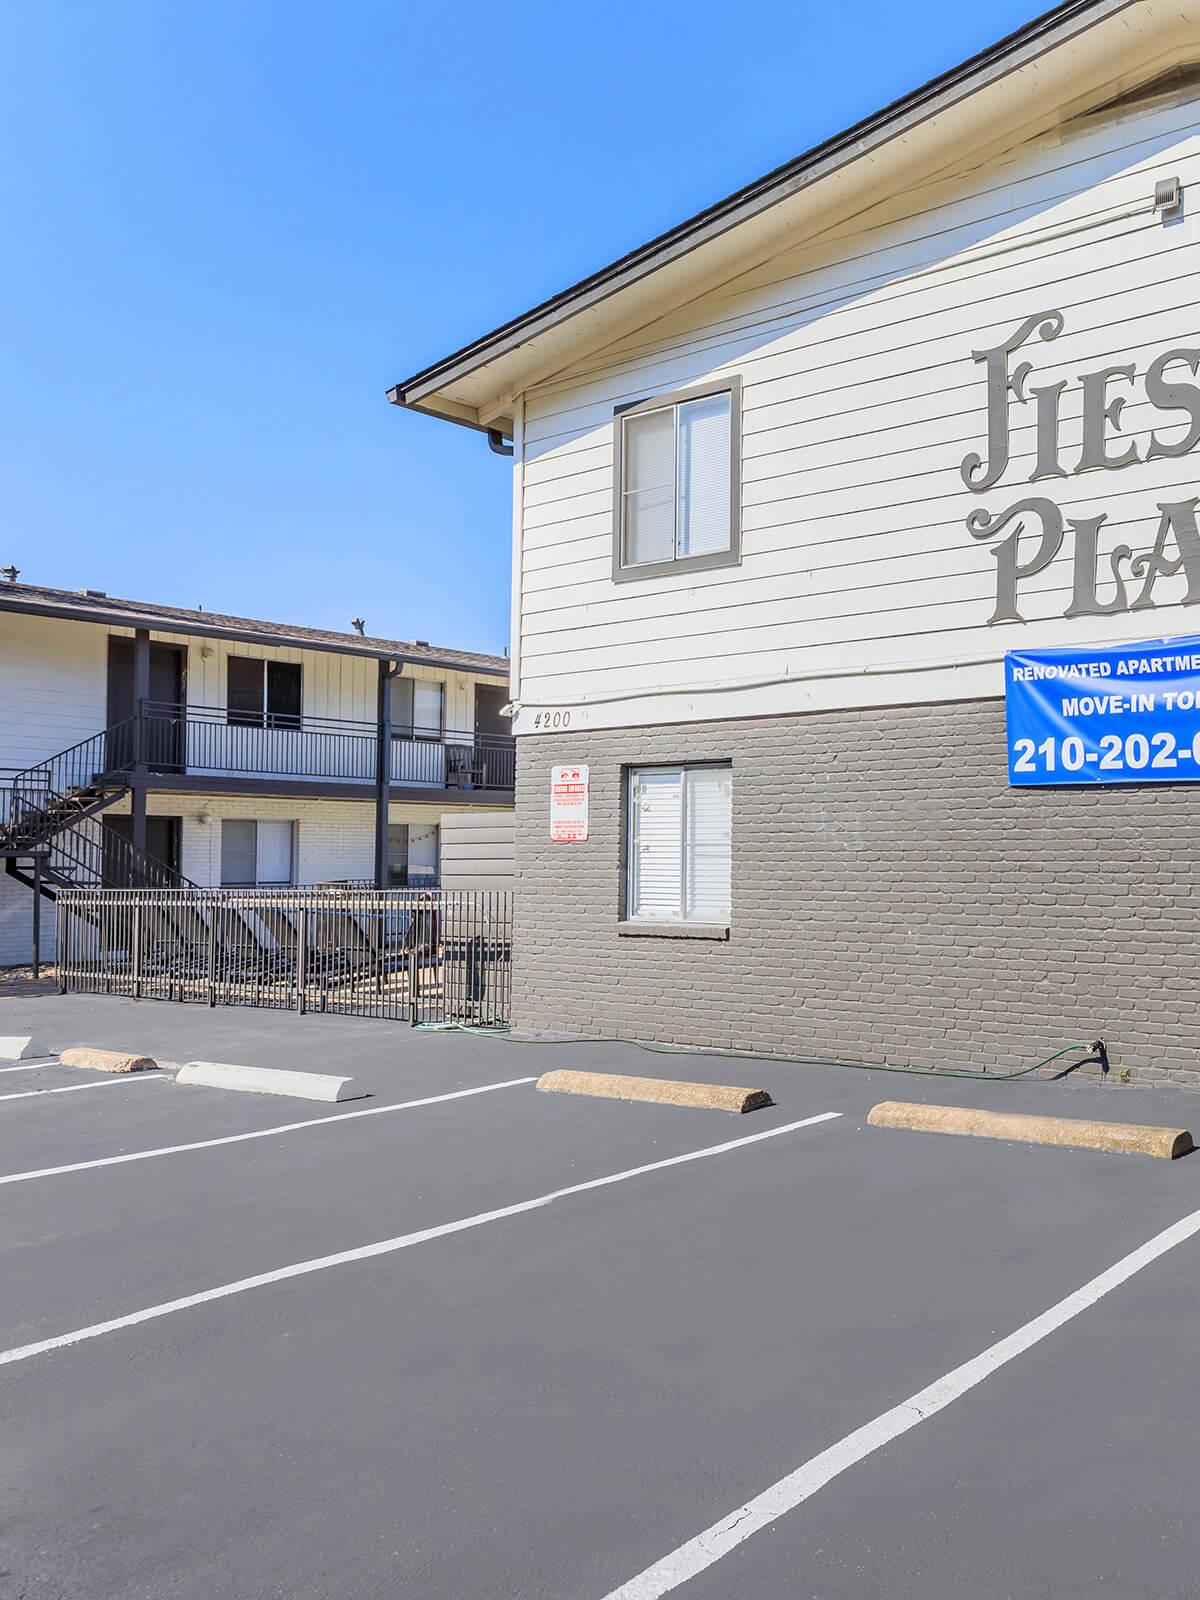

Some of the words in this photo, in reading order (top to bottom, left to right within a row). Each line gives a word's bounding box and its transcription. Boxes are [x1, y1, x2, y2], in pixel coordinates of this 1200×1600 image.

[1012, 661, 1112, 681] RENOVATED
[1062, 693, 1154, 717] MOVE-IN
[534, 711, 571, 728] 4200
